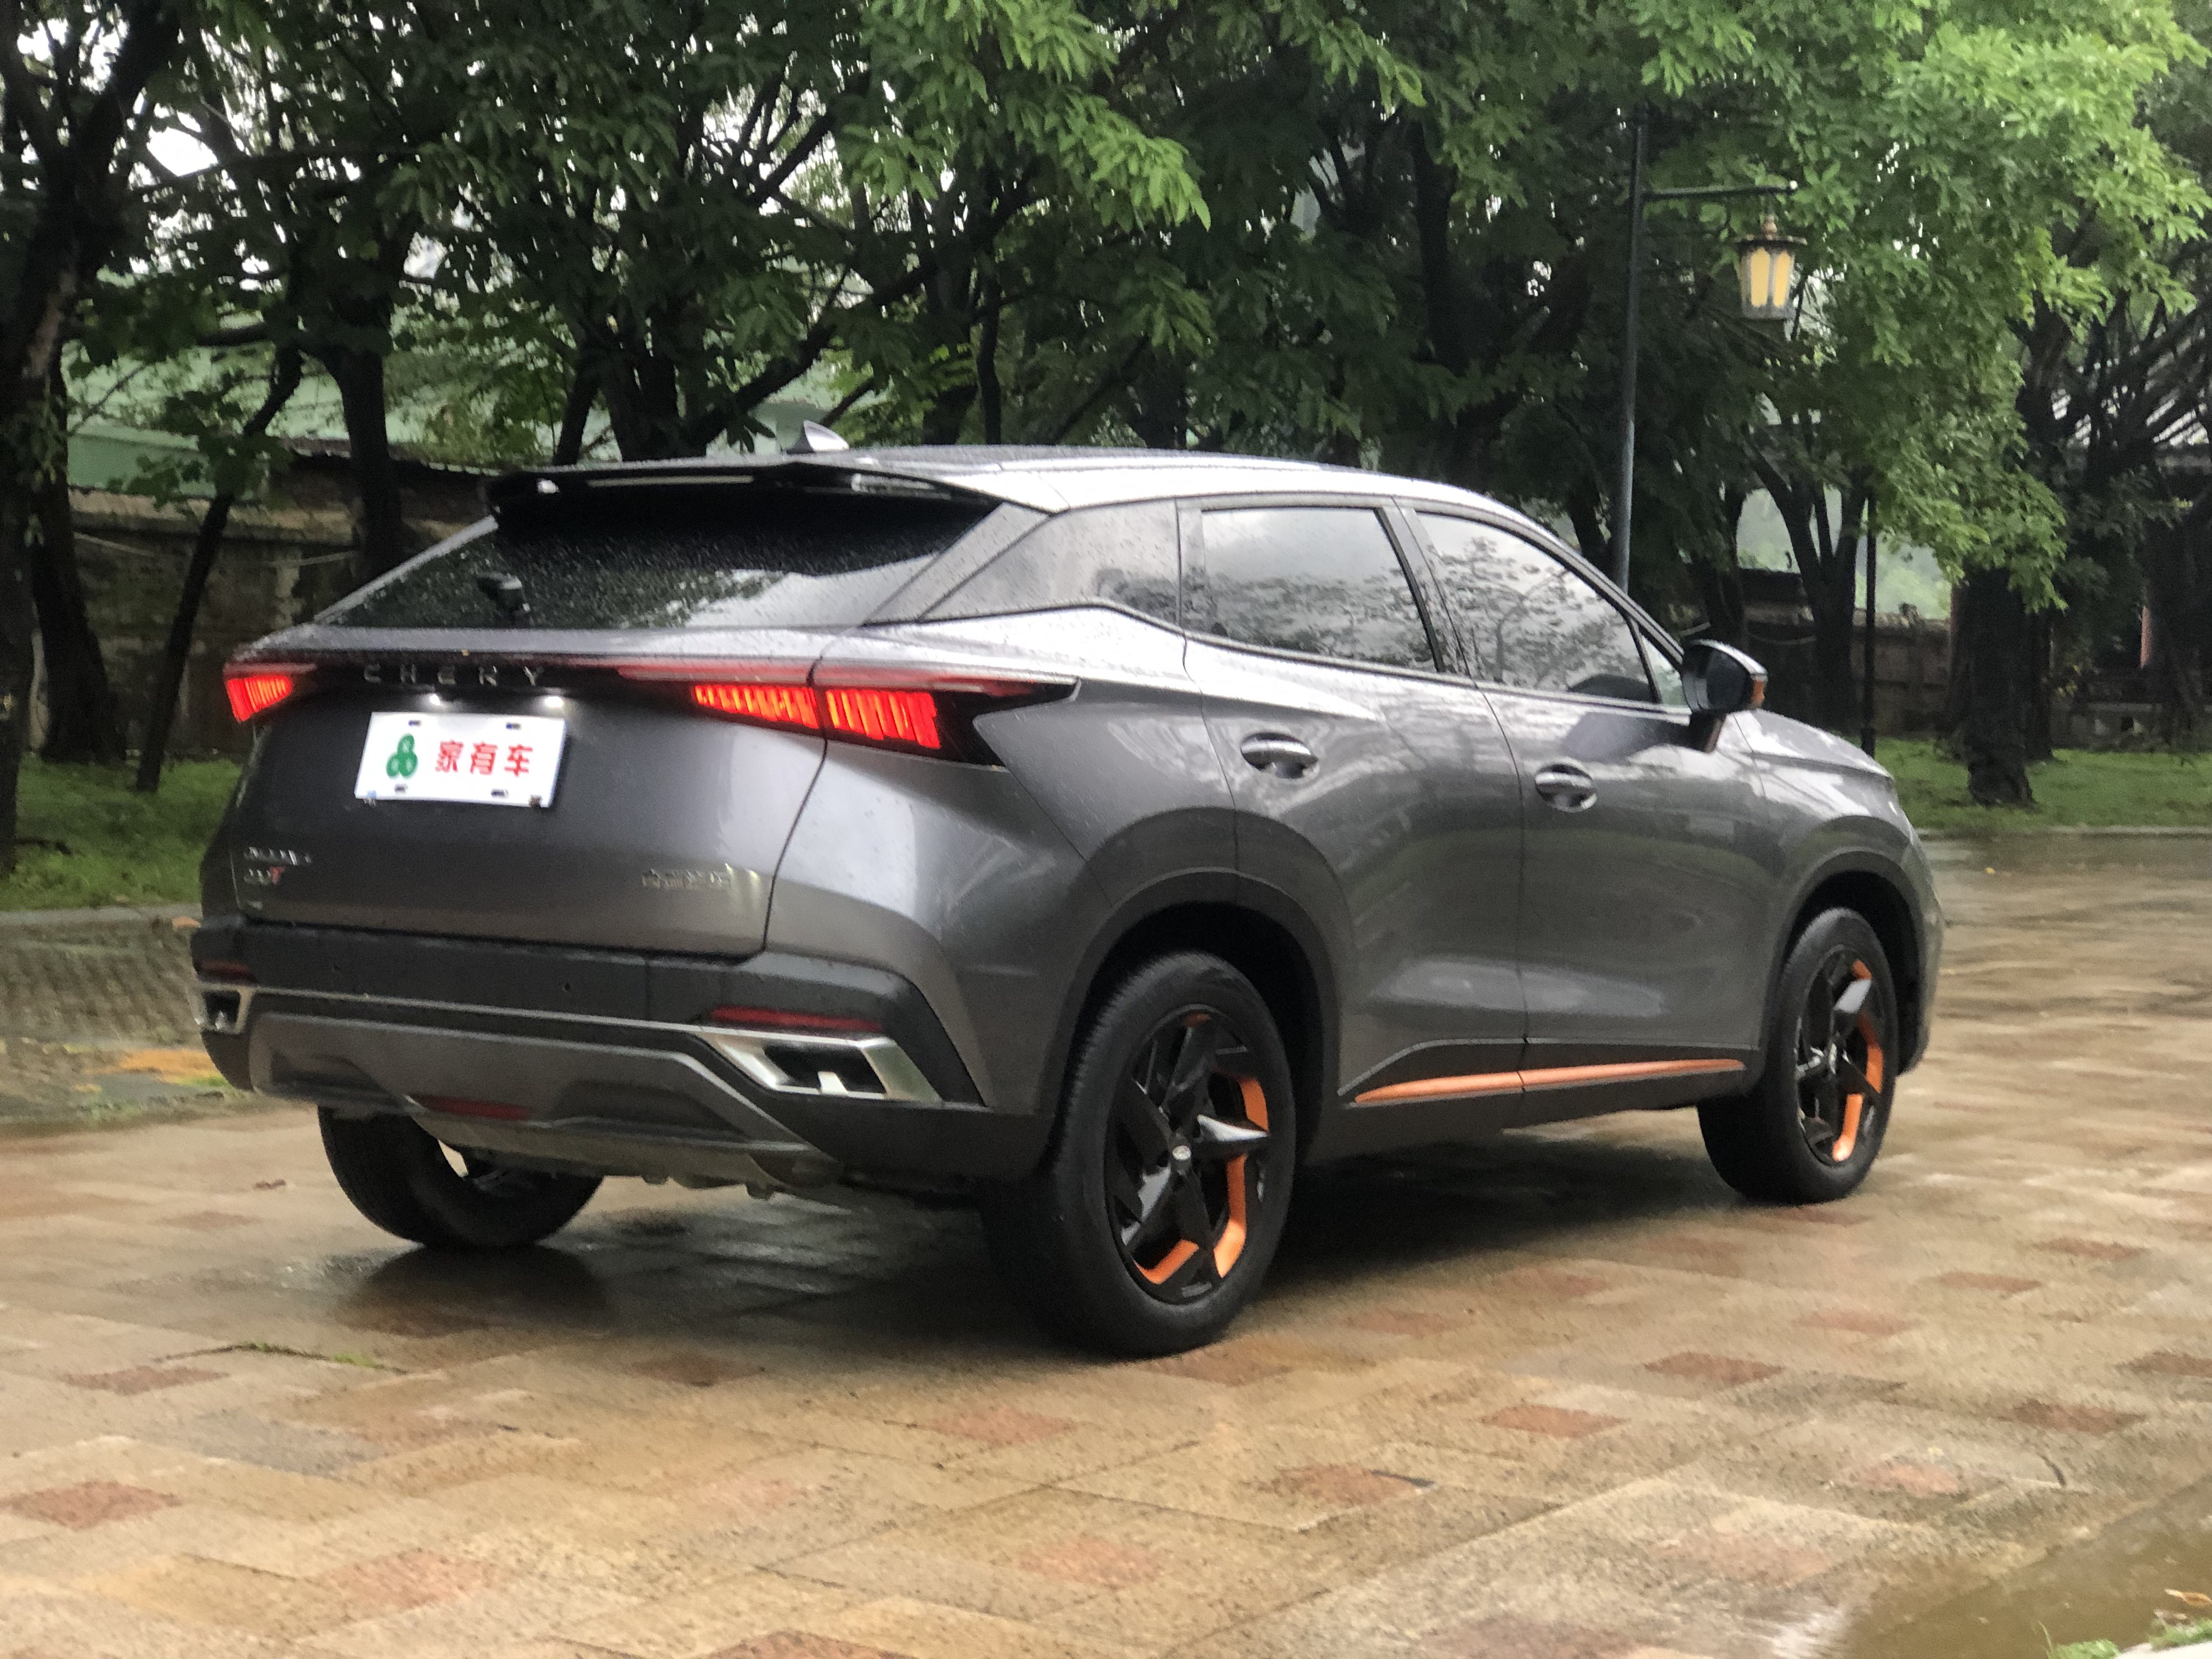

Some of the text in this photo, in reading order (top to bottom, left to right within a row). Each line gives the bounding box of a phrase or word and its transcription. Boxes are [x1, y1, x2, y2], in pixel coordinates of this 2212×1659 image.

[363, 663, 544, 686] CHERY
[435, 740, 533, 777] 家有车
